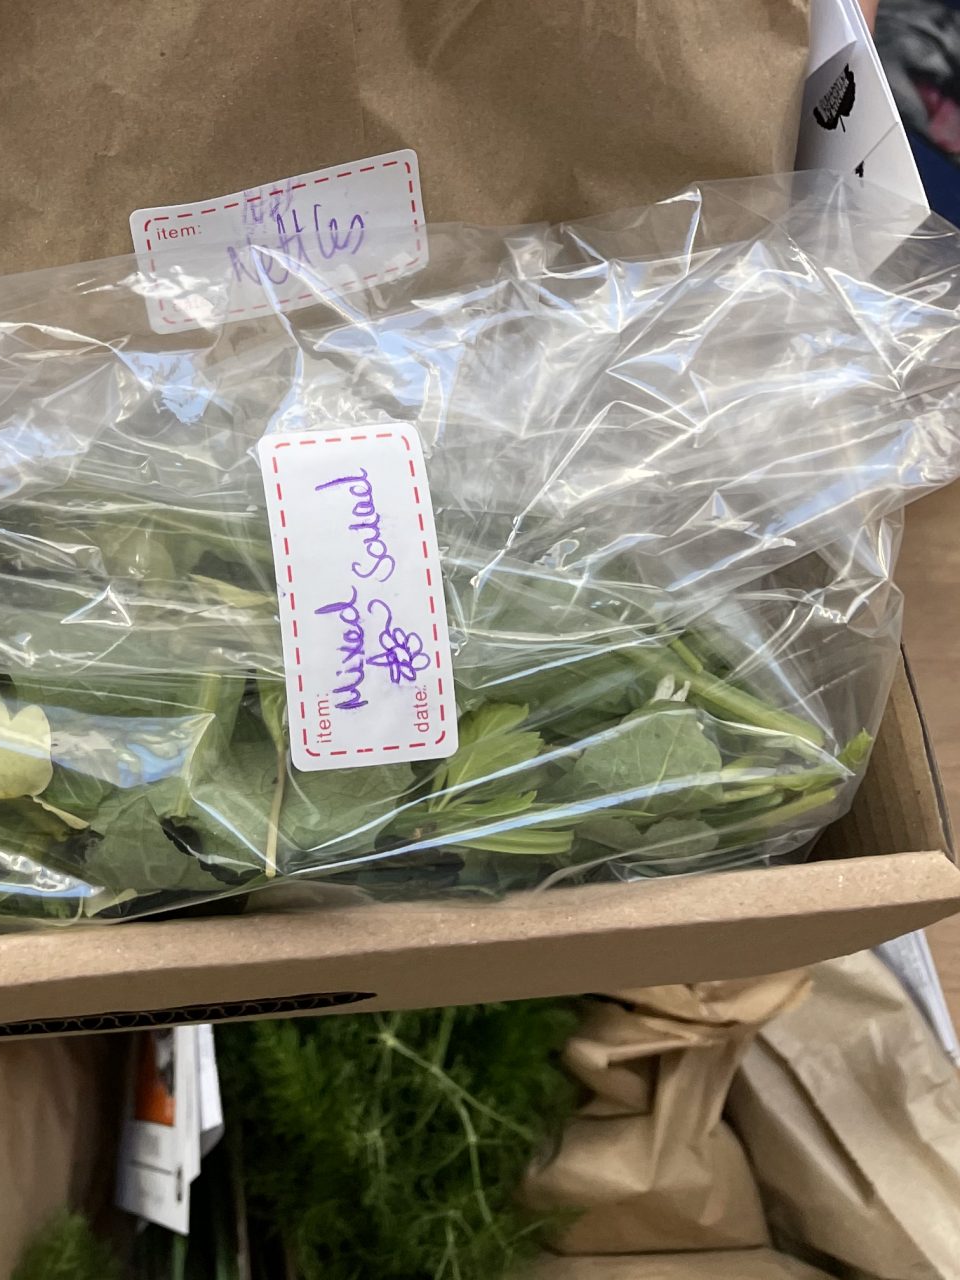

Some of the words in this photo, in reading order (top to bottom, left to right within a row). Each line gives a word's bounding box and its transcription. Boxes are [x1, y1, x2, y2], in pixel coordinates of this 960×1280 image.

[156, 223, 202, 241] item:
[227, 203, 366, 287] Nettles
[314, 467, 396, 583] Salad
[314, 585, 369, 711] Mixed
[316, 692, 333, 744] item:
[413, 684, 431, 733] date:
